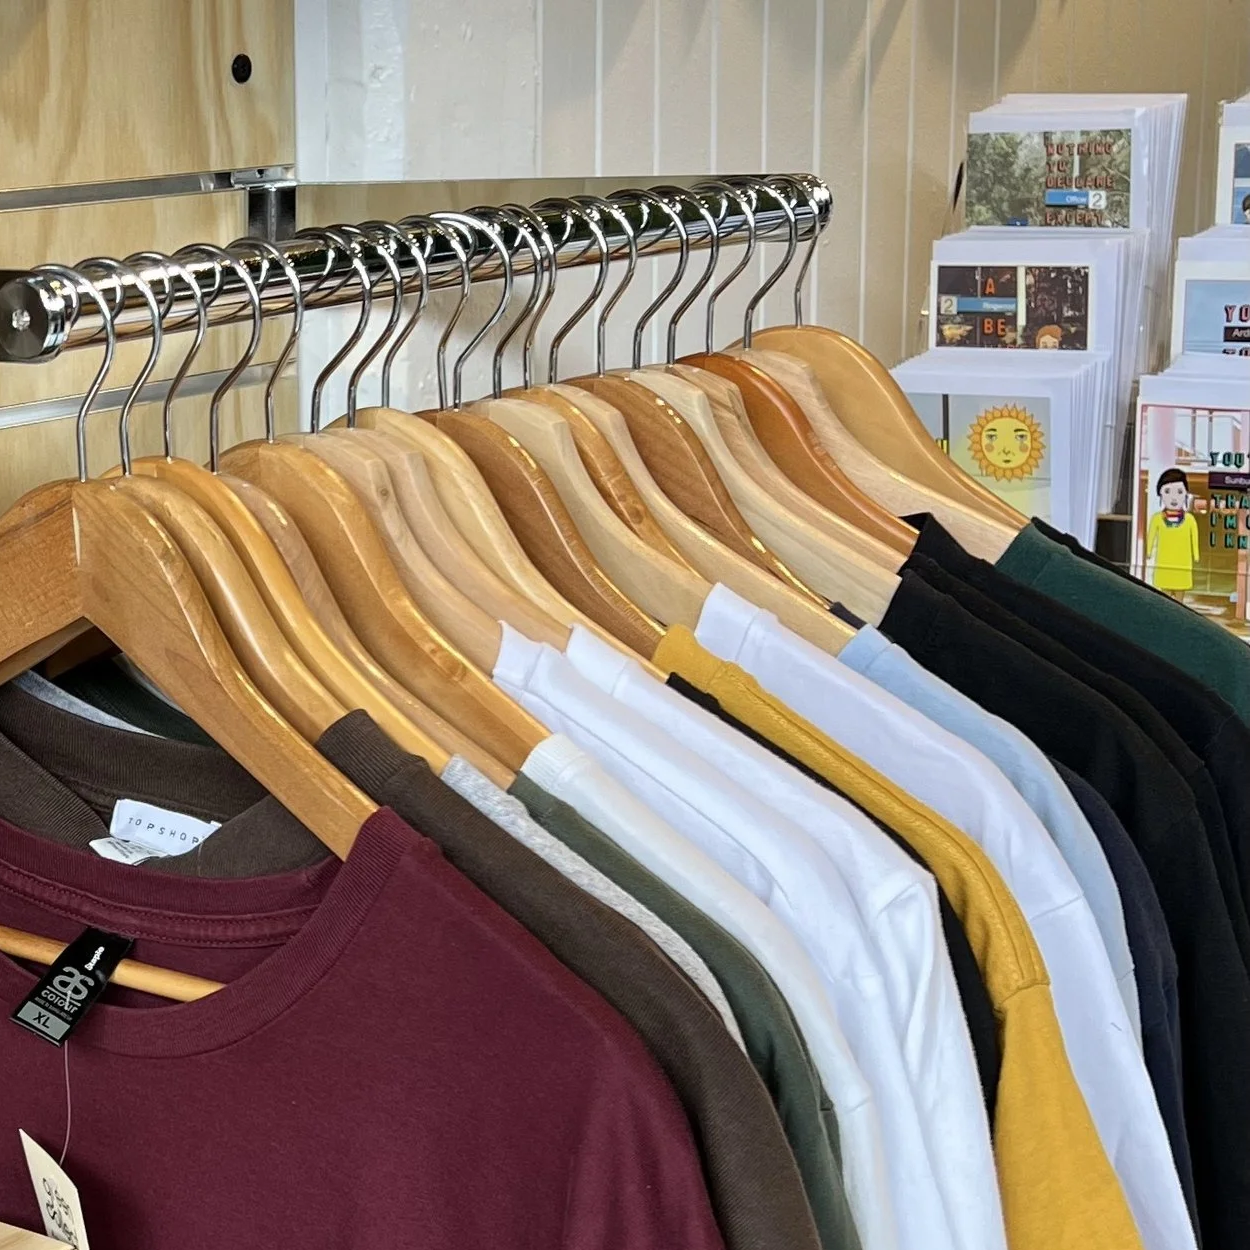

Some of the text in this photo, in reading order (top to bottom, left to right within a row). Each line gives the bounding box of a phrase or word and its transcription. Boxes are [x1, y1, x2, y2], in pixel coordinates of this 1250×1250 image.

[1091, 192, 1103, 207] 2
[984, 277, 995, 295] A
[944, 299, 953, 313] 2
[984, 318, 1006, 337] BE
[128, 817, 199, 844] TOPSHOP
[84, 946, 105, 971] Staple
[41, 989, 78, 1013] colour
[33, 1012, 50, 1029] XL
